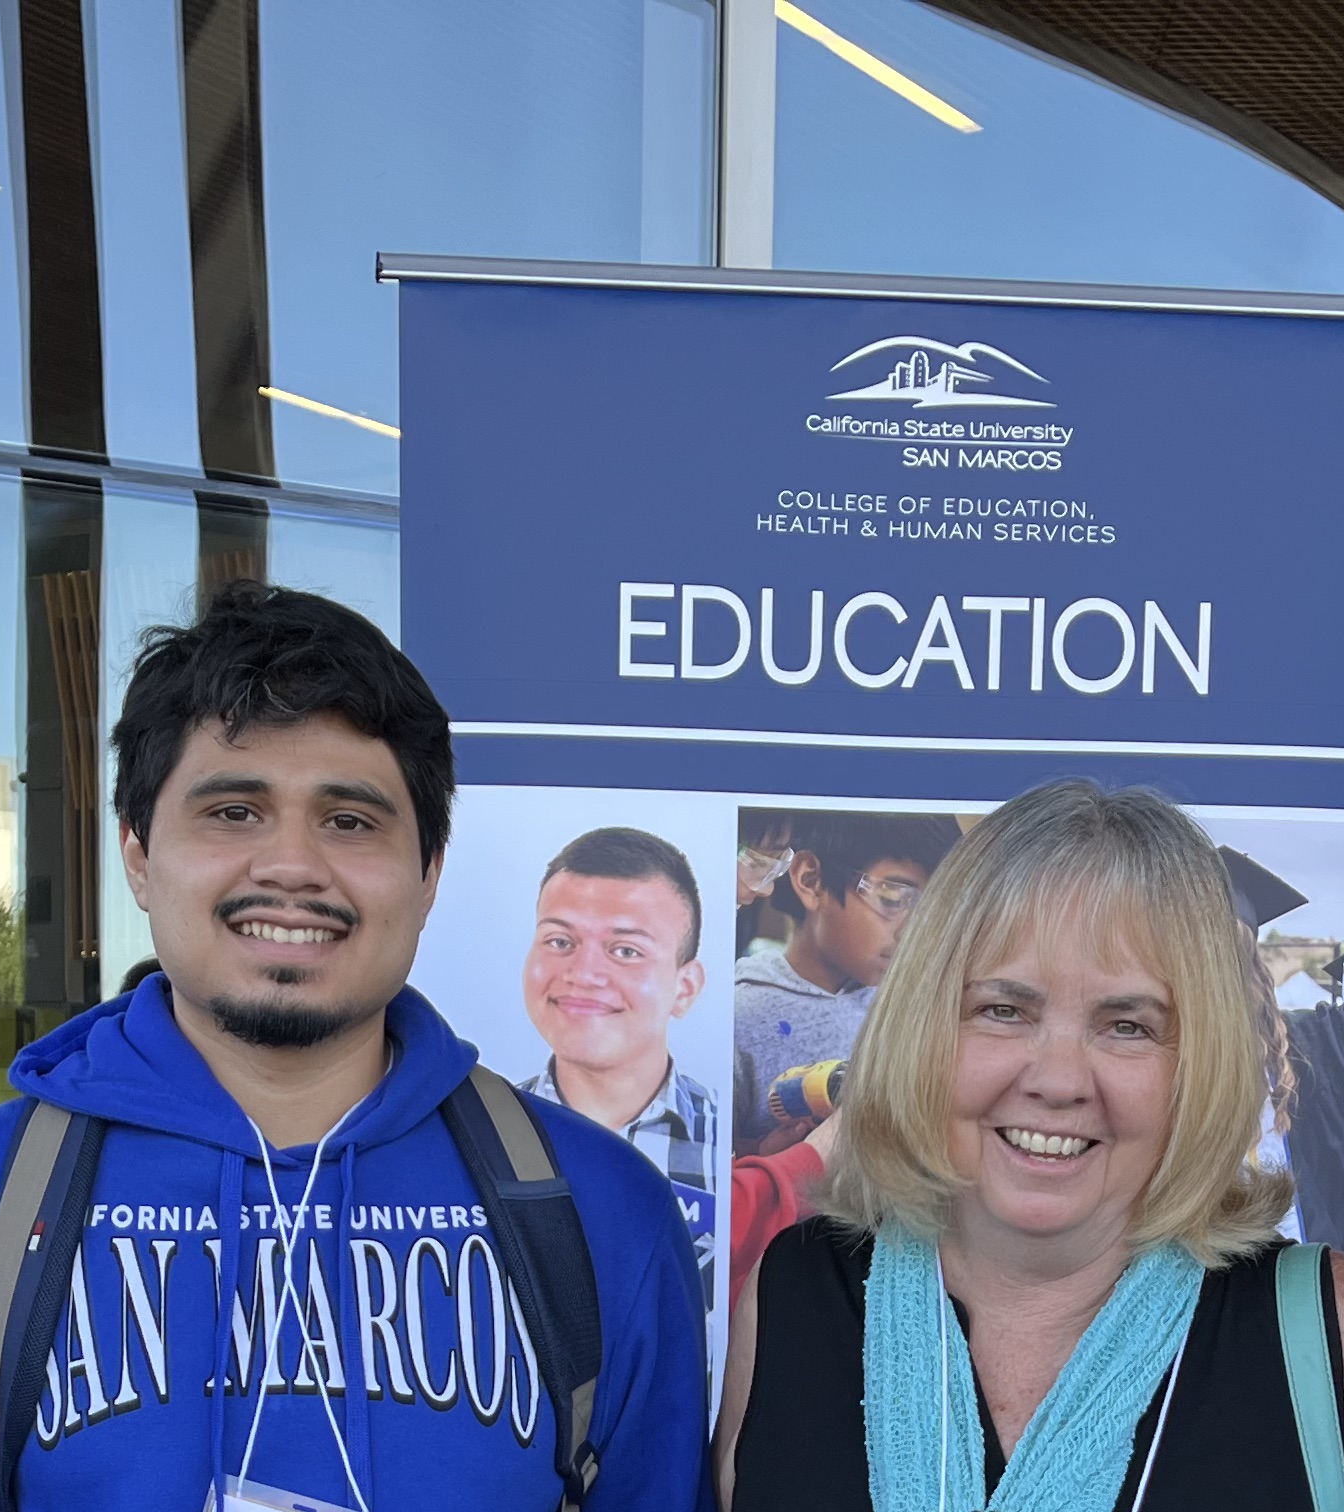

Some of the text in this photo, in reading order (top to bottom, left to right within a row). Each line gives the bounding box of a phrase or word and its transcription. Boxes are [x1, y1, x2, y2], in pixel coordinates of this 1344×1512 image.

[806, 414, 1074, 446] California State University
[902, 447, 1062, 471] SAN MARCOS
[777, 490, 1095, 520] COLLEGE OF EDUCATION,
[756, 513, 1116, 544] HEALTH & HUMAN SERVICES
[618, 581, 1212, 695] EDUCATION
[239, 1204, 333, 1231] STATE
[203, 1232, 540, 1450] MARCOS
